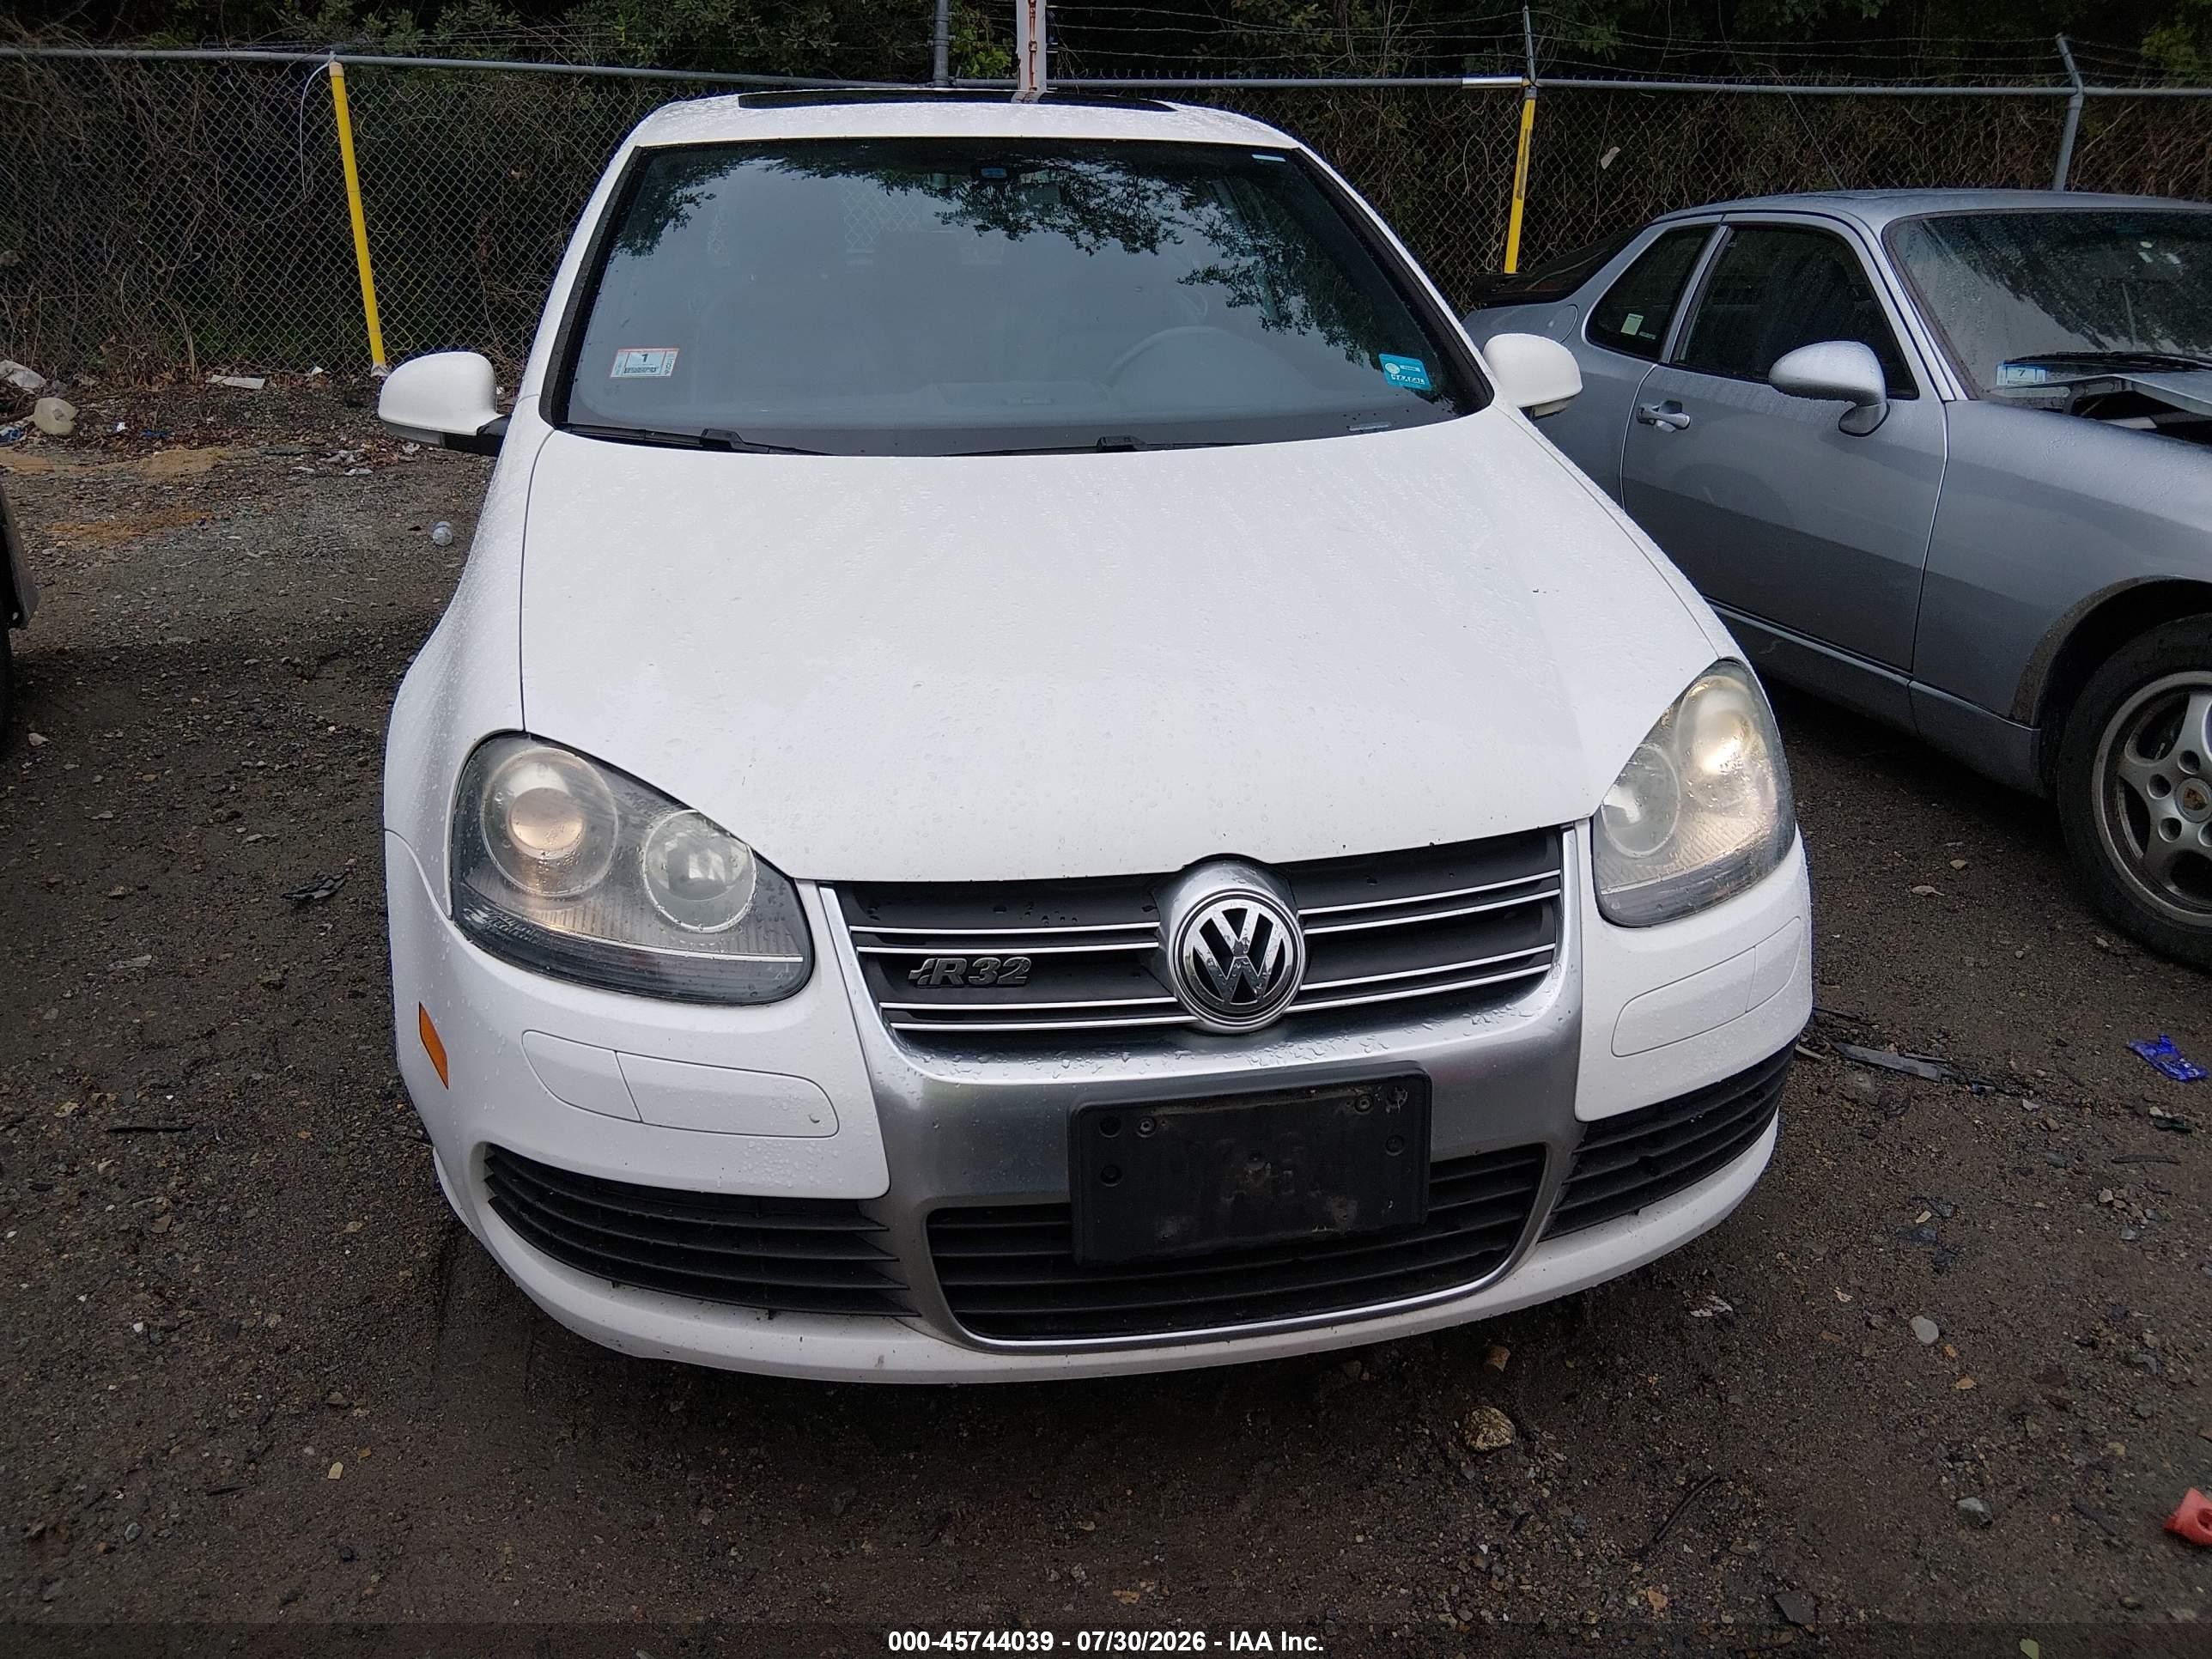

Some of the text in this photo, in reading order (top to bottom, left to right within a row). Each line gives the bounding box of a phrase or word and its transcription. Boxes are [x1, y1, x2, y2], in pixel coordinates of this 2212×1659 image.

[641, 353, 649, 362] 1
[1182, 898, 1294, 1013] VW
[929, 956, 1032, 987] R32
